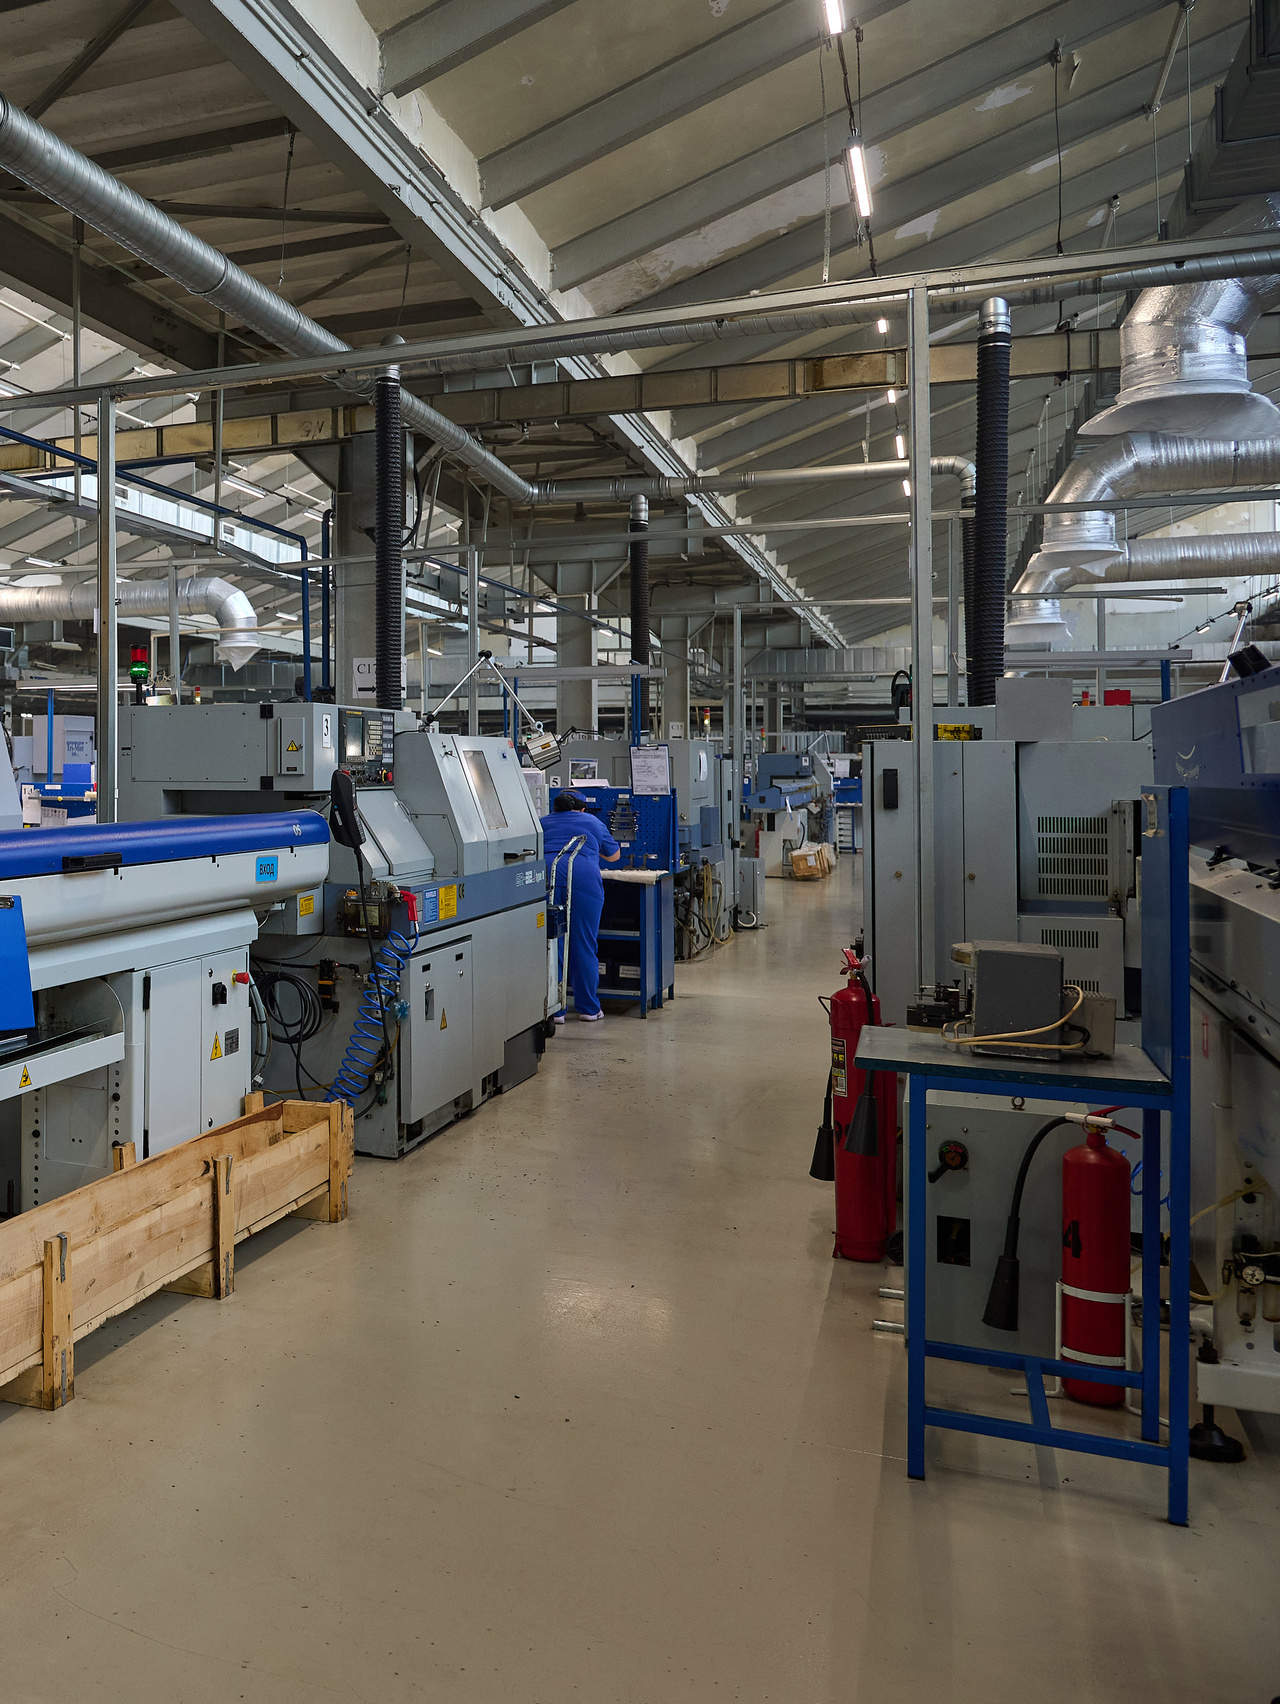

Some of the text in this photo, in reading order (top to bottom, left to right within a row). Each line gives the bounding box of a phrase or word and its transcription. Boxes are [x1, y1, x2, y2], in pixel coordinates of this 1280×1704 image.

[323, 718, 329, 737] 3
[551, 777, 559, 787] 5
[259, 863, 275, 877] ВХОД
[1063, 1220, 1081, 1258] 4
